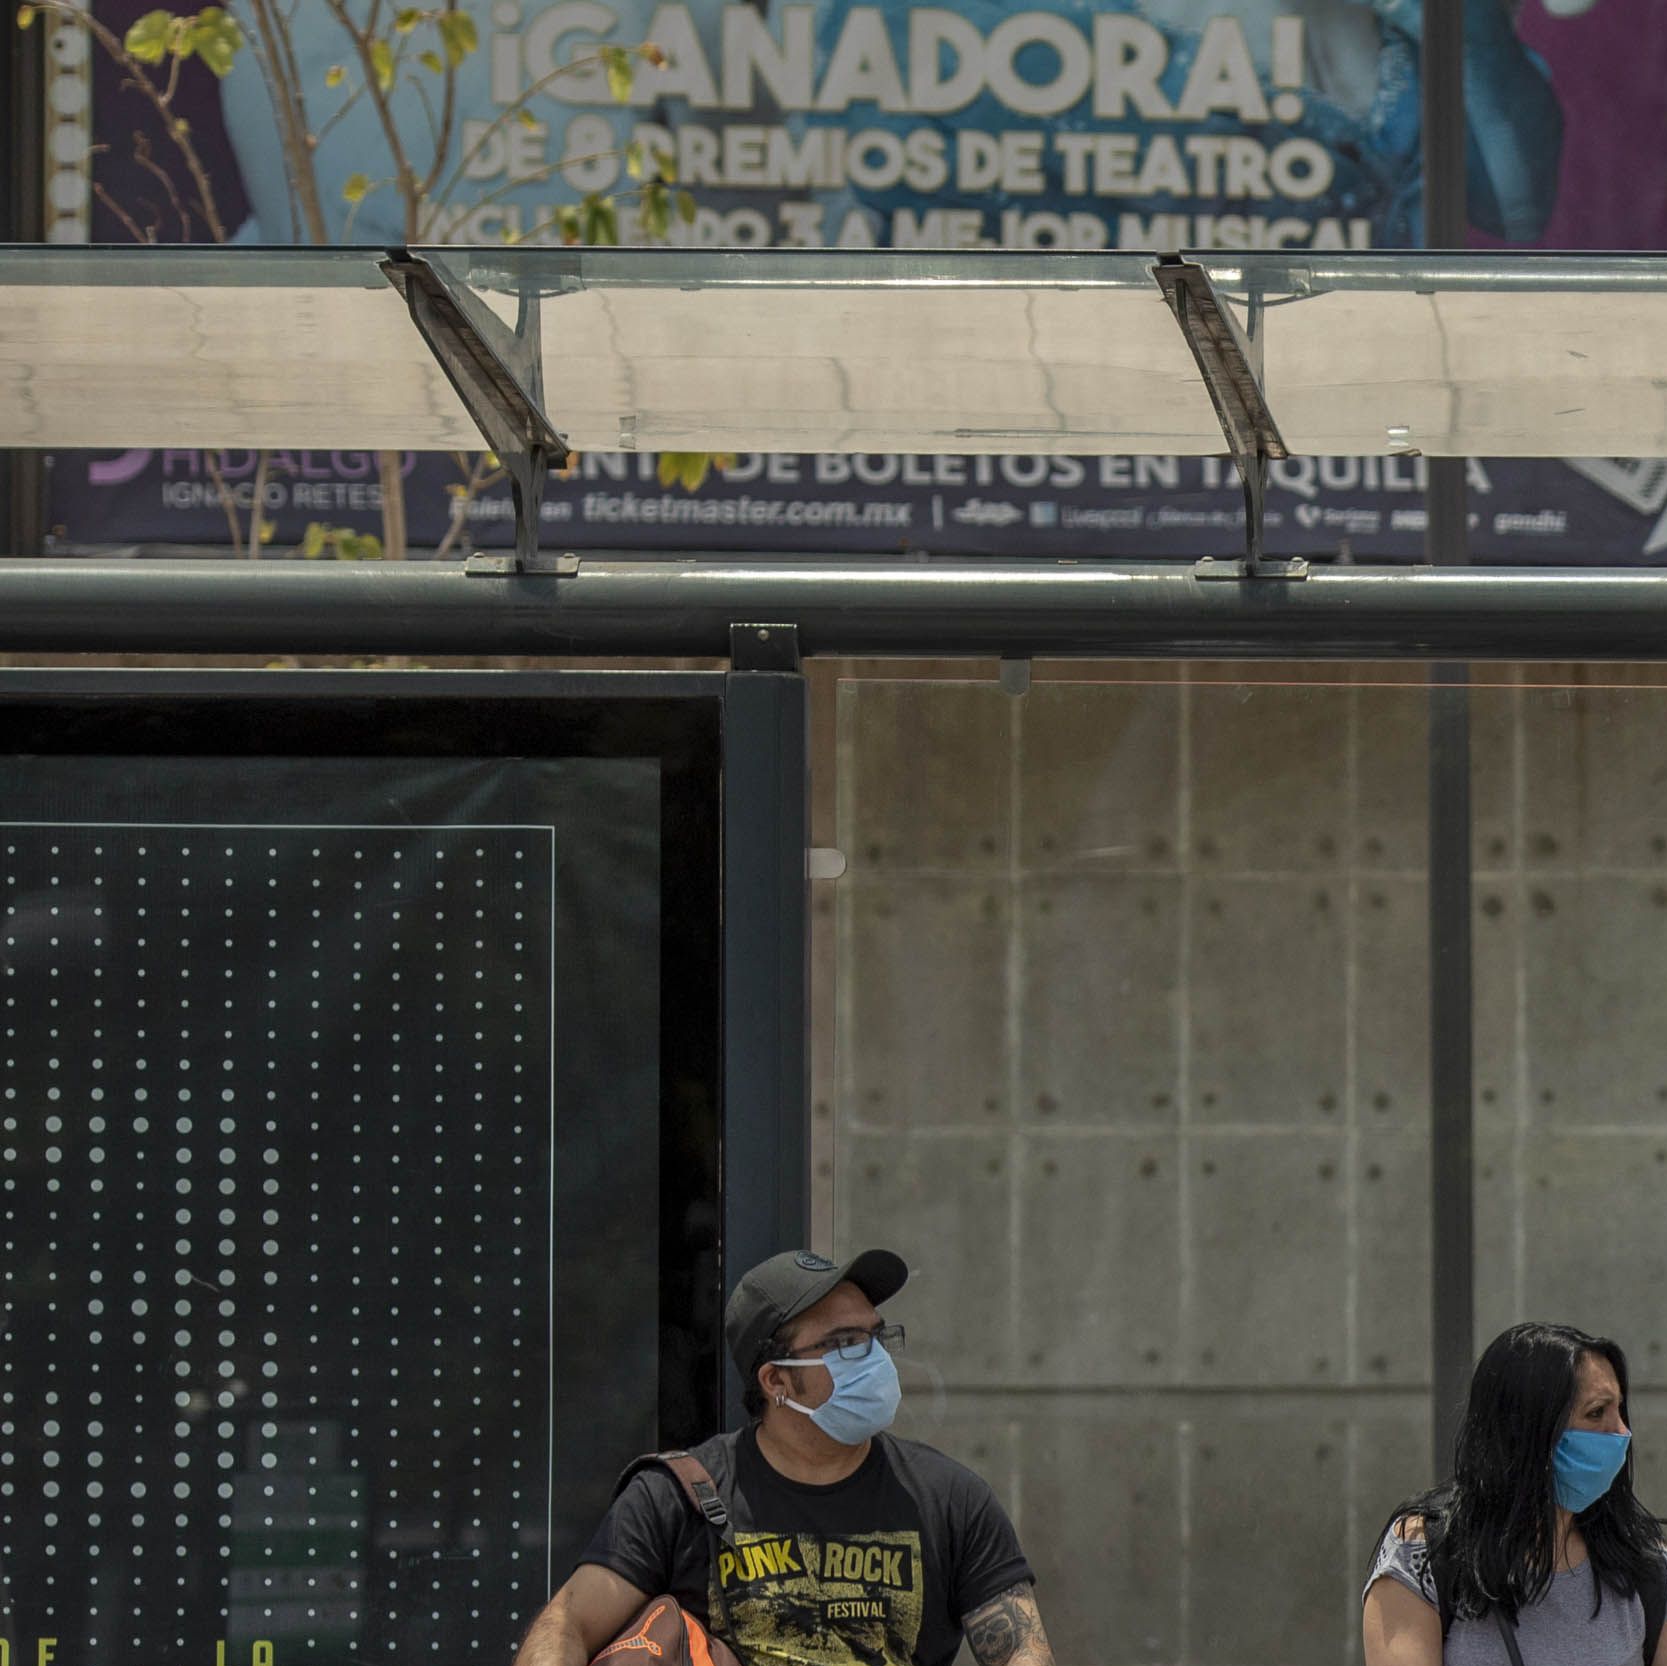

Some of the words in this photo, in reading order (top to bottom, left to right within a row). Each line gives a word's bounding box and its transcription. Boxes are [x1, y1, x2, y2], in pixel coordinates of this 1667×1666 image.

[462, 118, 549, 182] DE
[560, 113, 618, 192] 8
[956, 128, 1046, 193] DE
[1054, 132, 1334, 199] TEATRO
[815, 452, 1086, 487] BOLETOS
[1100, 455, 1179, 488] EN
[583, 490, 912, 527] ticketmaster.com.mx
[719, 1539, 800, 1588] PUNK
[824, 1543, 903, 1586] ROCK
[827, 1602, 886, 1619] FESTIVAL
